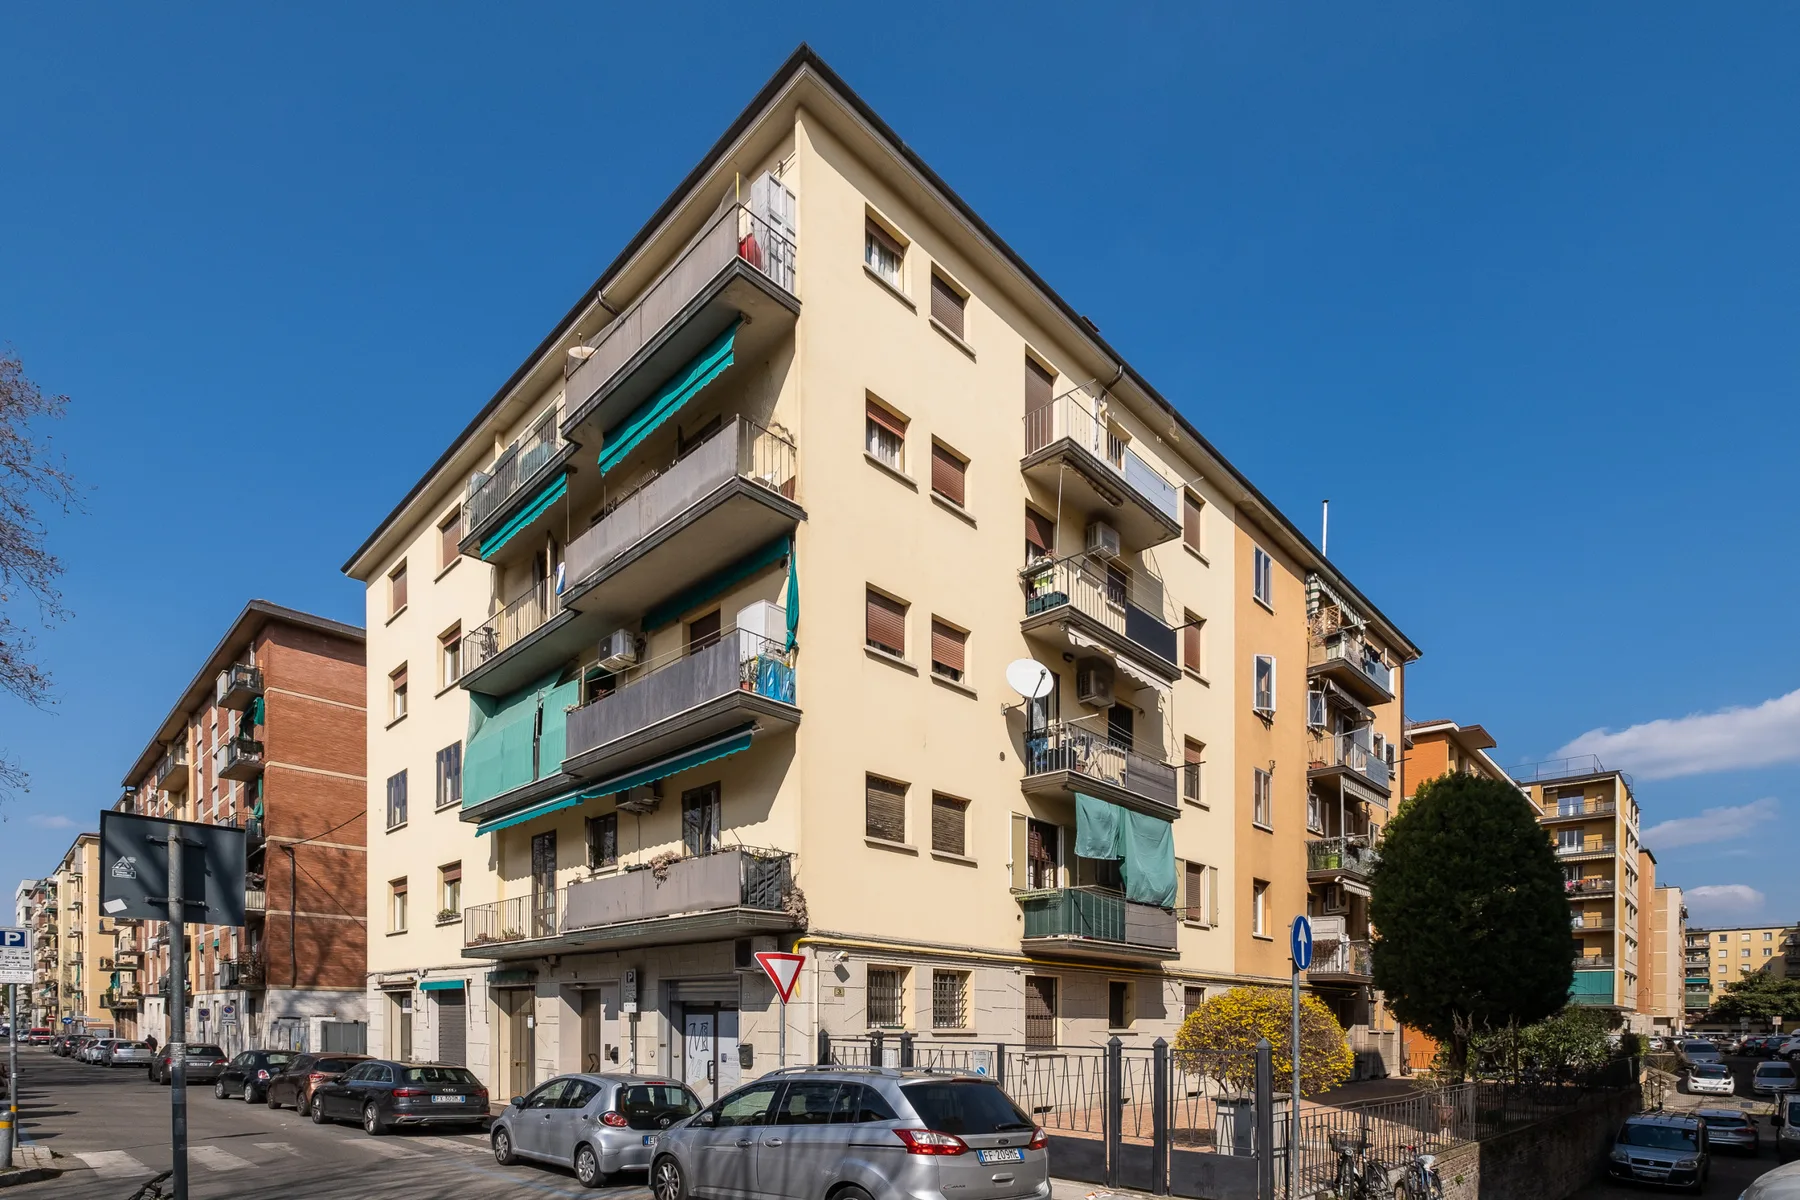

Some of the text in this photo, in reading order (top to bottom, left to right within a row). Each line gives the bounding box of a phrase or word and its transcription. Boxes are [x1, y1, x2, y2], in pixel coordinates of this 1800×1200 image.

[5, 931, 21, 946] P
[627, 972, 633, 983] P
[872, 1038, 878, 1047] 3
[983, 1150, 993, 1161] FF
